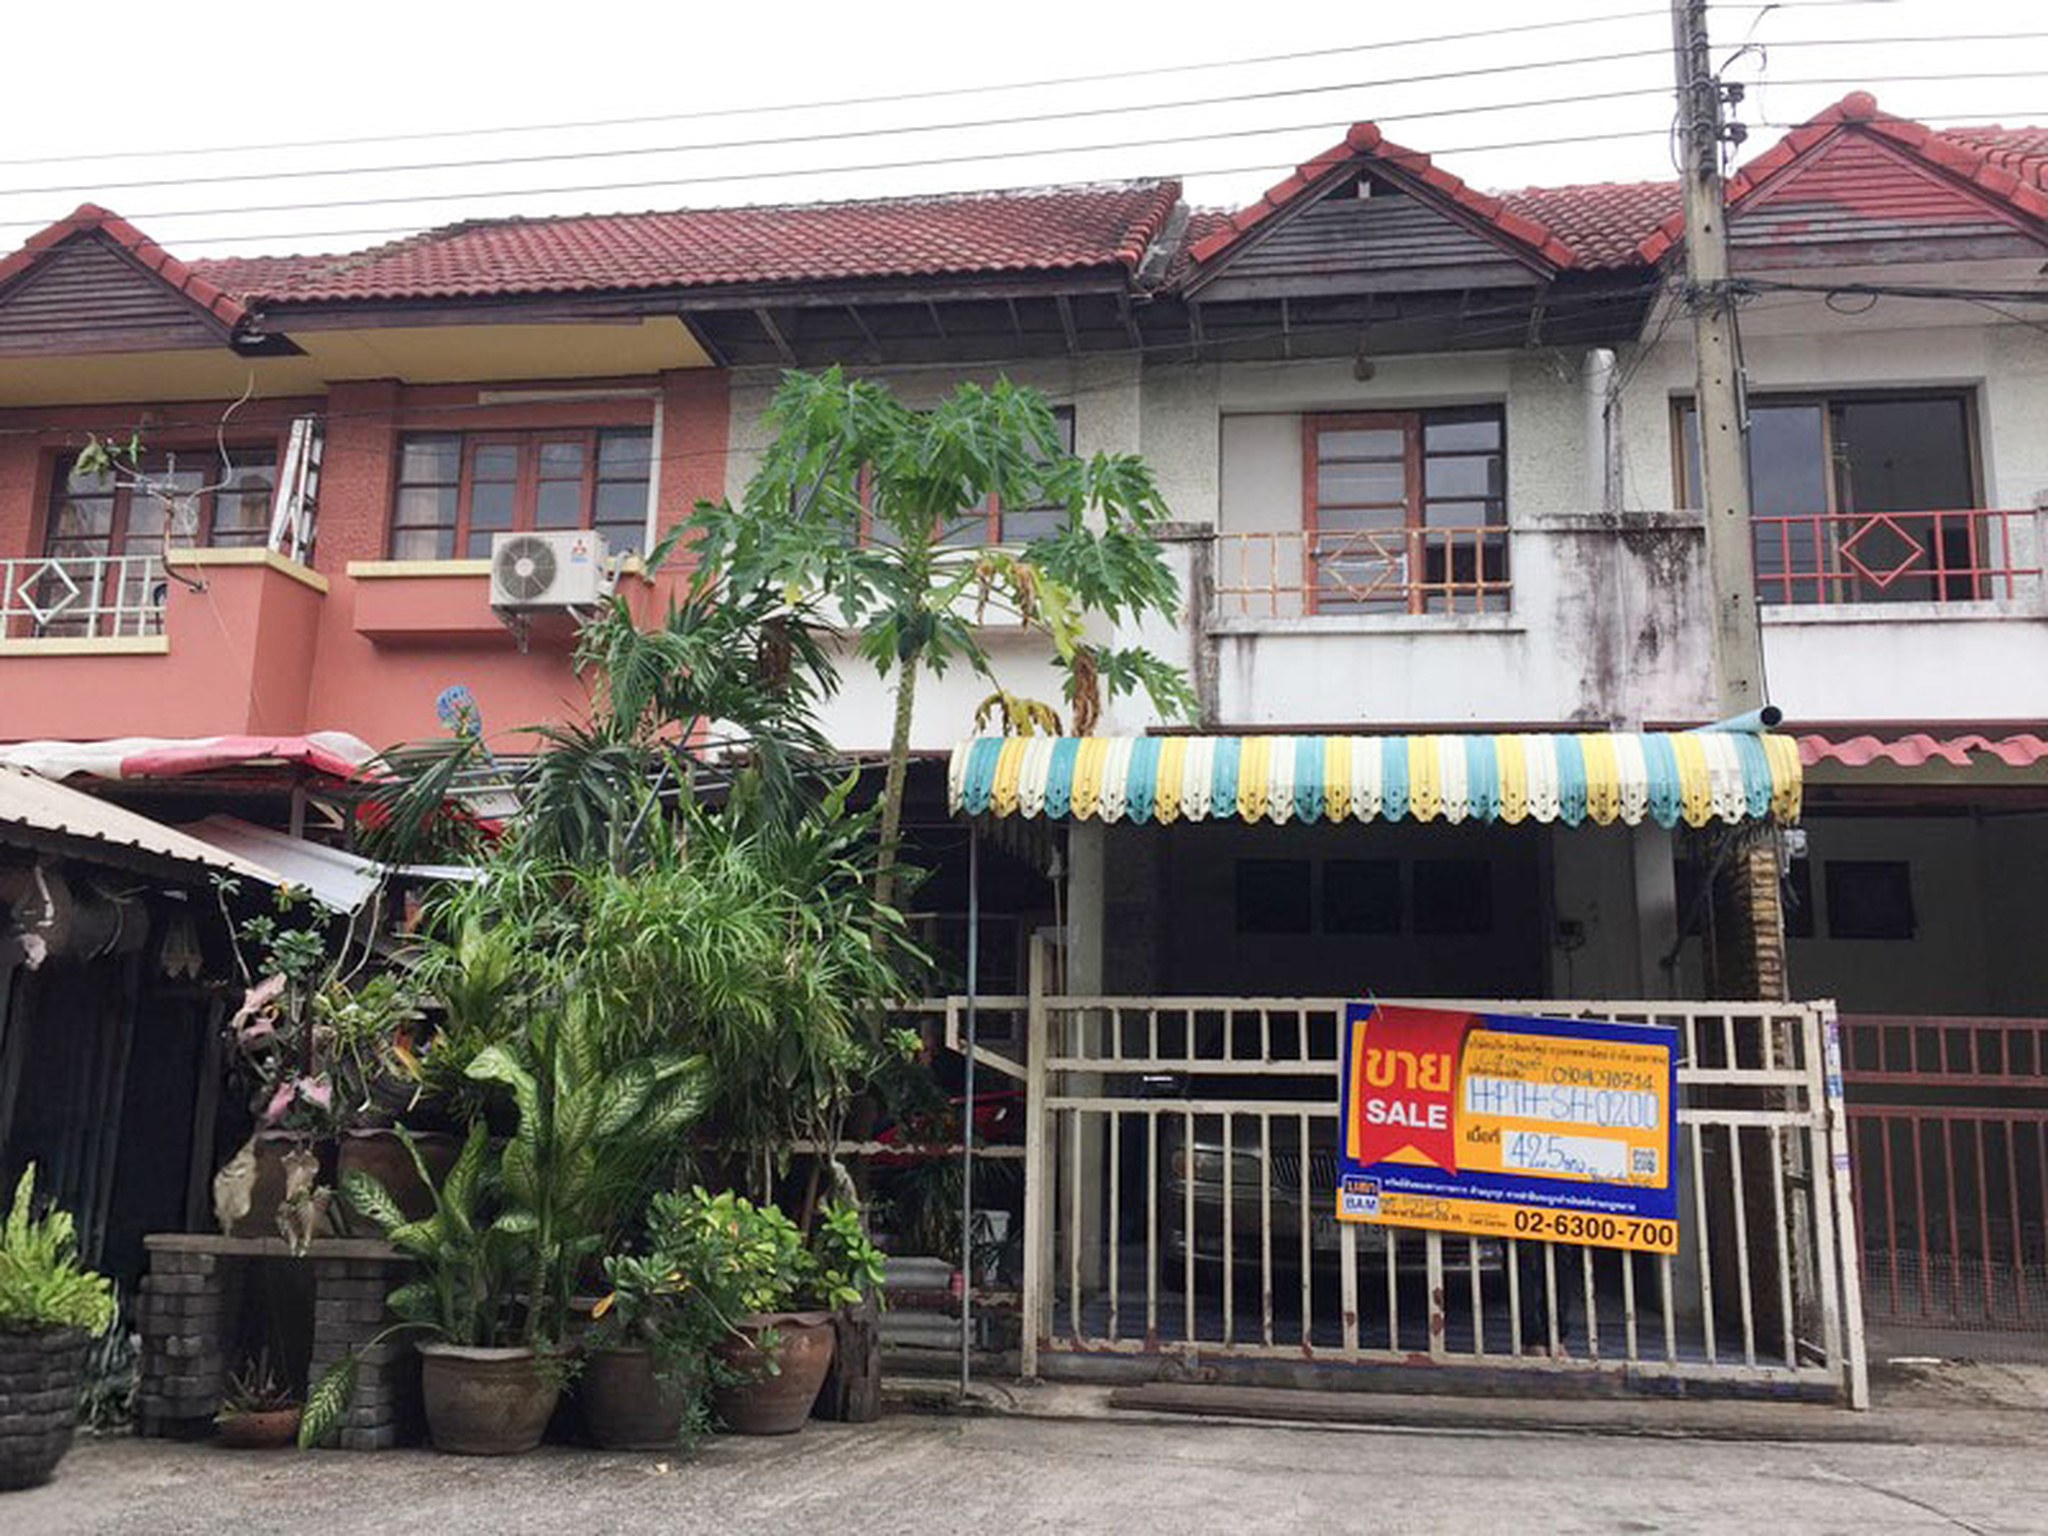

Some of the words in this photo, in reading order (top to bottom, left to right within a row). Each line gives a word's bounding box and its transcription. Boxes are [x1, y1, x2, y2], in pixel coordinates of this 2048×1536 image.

[1366, 1048, 1450, 1091] ขาย
[1366, 1099, 1448, 1129] SALE
[1514, 1210, 1674, 1246] 02-6300-700
